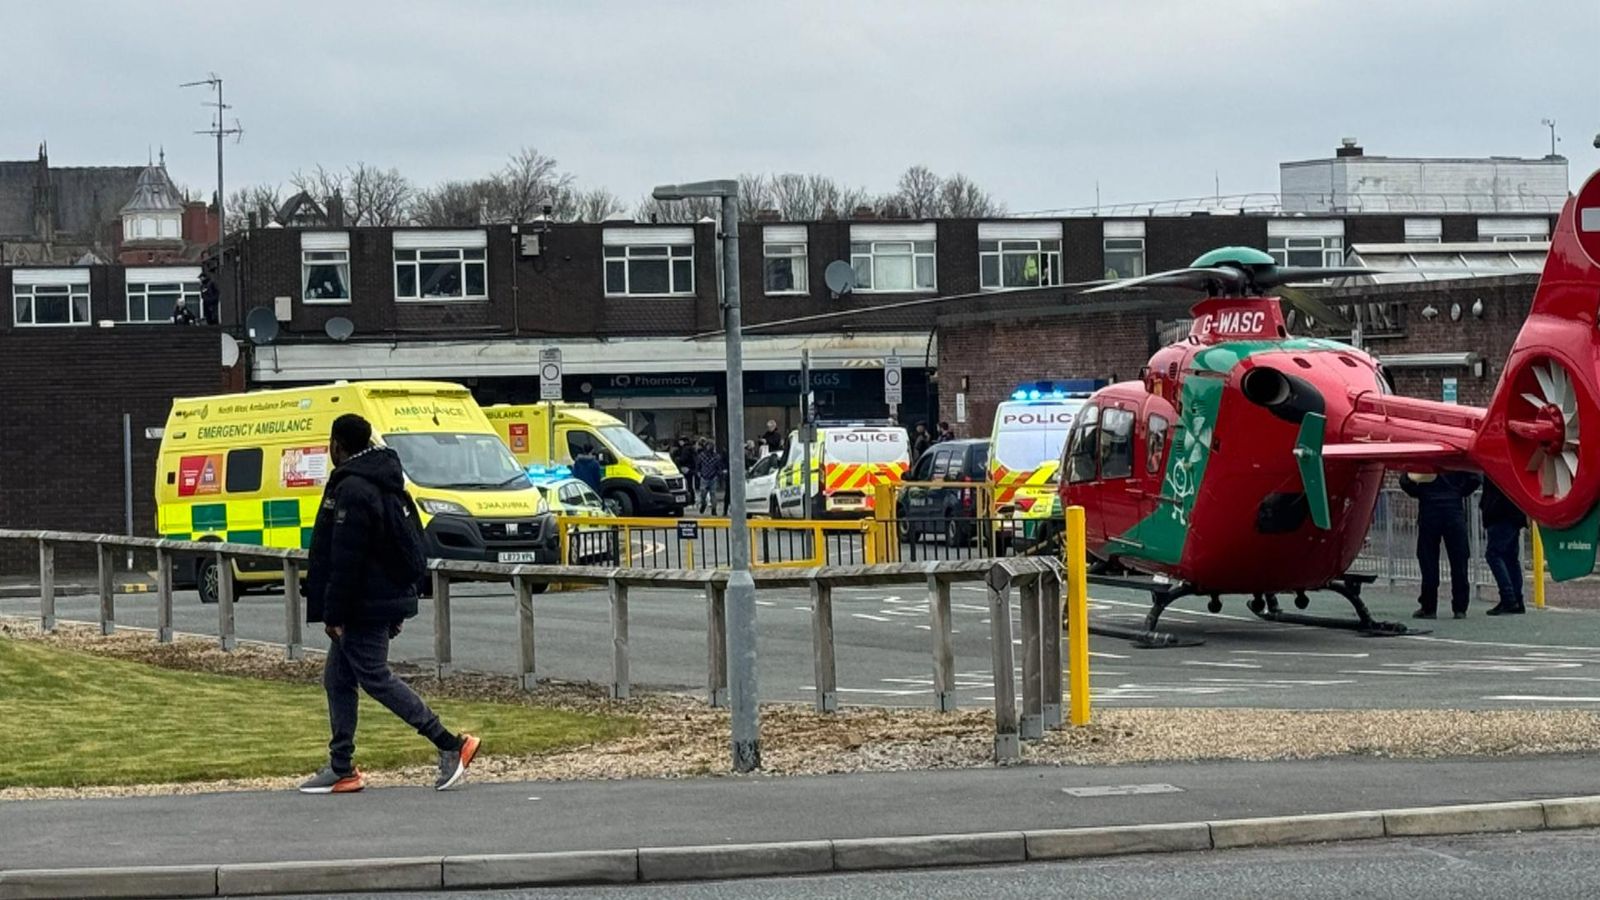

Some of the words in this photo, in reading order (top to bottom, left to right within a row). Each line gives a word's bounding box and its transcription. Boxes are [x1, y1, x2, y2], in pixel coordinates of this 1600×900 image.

[1202, 311, 1265, 334] G-WASC
[634, 375, 697, 387] Pharmacy
[788, 373, 840, 386] GGGS
[249, 402, 279, 411] Ambulance
[279, 400, 299, 408] Service
[394, 406, 465, 416] AMBULANCE
[198, 423, 254, 439] EMERGENCY
[255, 418, 313, 435] AMBULANCE
[833, 433, 900, 442] POLICE
